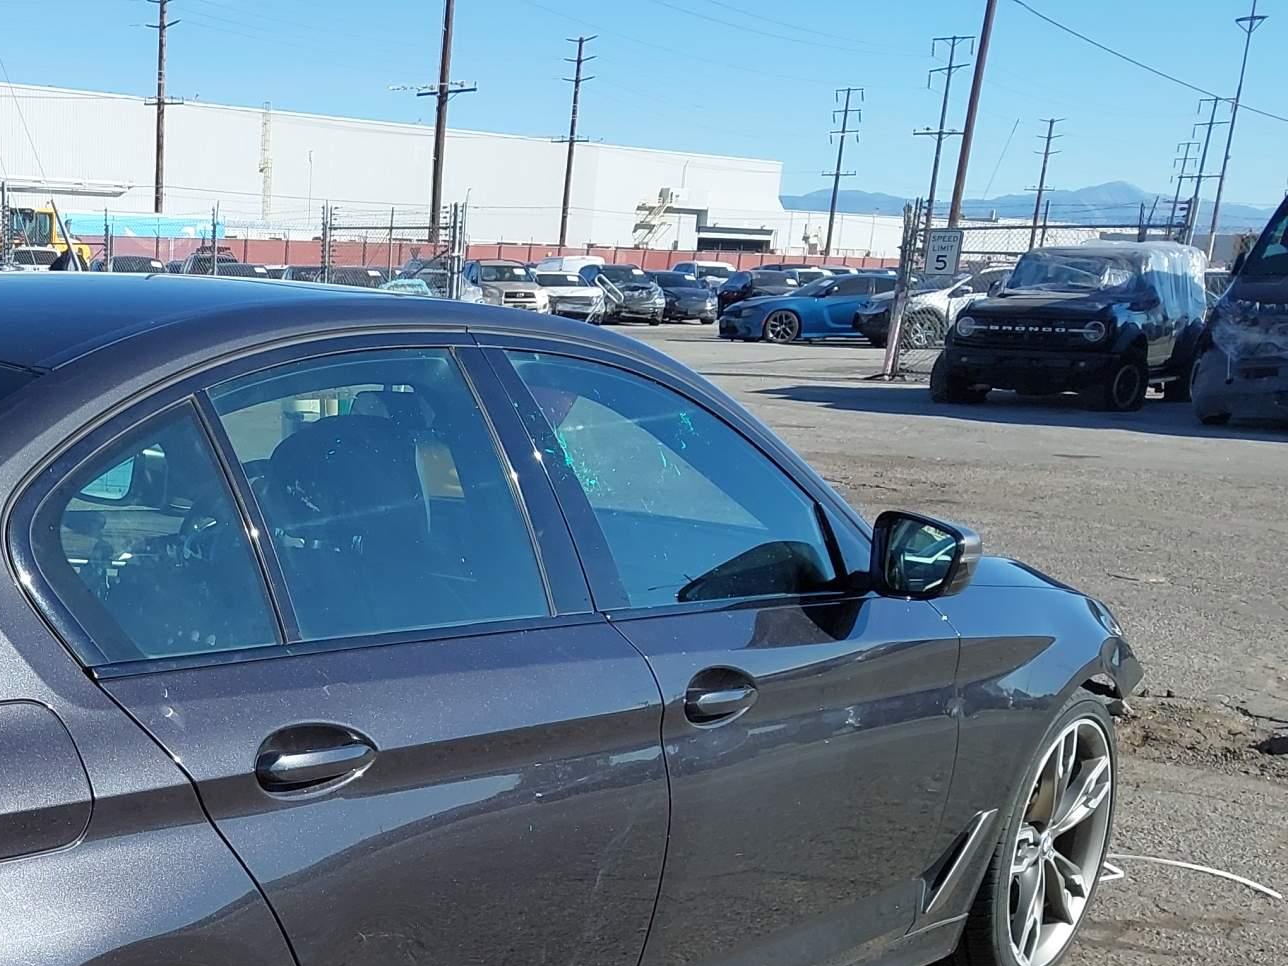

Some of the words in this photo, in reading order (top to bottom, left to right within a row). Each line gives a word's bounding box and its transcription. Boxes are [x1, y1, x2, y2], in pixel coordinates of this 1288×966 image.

[932, 244, 955, 252] LIMIT
[934, 254, 948, 271] 5
[989, 325, 1066, 333] BRONCO
